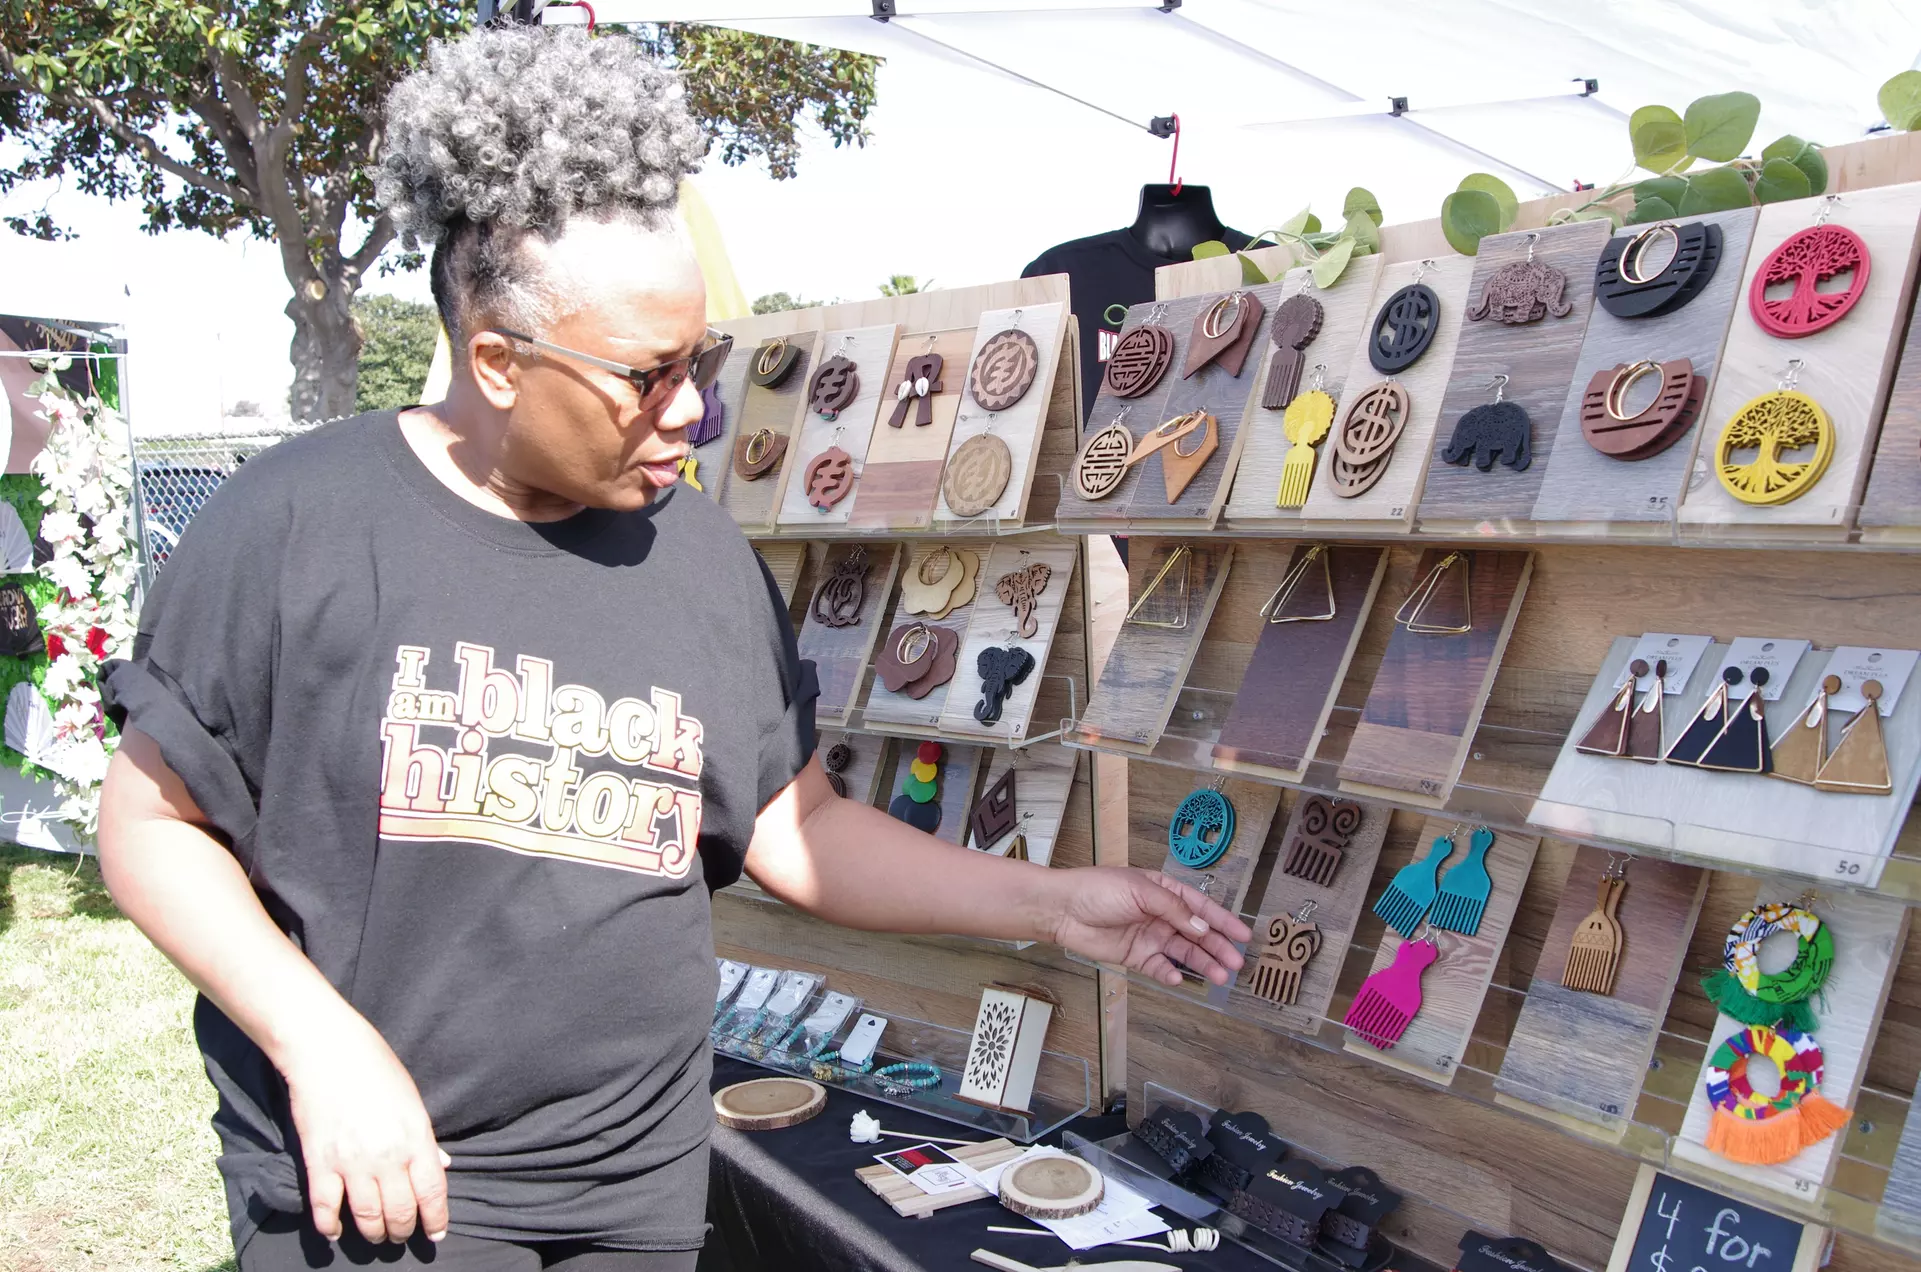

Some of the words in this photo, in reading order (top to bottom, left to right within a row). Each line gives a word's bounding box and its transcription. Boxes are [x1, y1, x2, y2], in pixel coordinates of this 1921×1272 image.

[1391, 507, 1404, 516] 22
[393, 645, 431, 690] I
[390, 688, 459, 722] am
[453, 640, 705, 781] black
[379, 718, 704, 880] history
[1835, 859, 1861, 876] 50
[1221, 1119, 1243, 1136] Fashion
[1239, 1131, 1267, 1151] Jewelry
[1266, 1169, 1294, 1186] Fashion
[1290, 1180, 1324, 1201] Jewelry
[1325, 1177, 1352, 1193] Fashion
[1347, 1187, 1380, 1206] Jewelry
[1657, 1192, 1682, 1240] 4
[1704, 1208, 1772, 1268] for
[1478, 1244, 1516, 1265] Fashion
